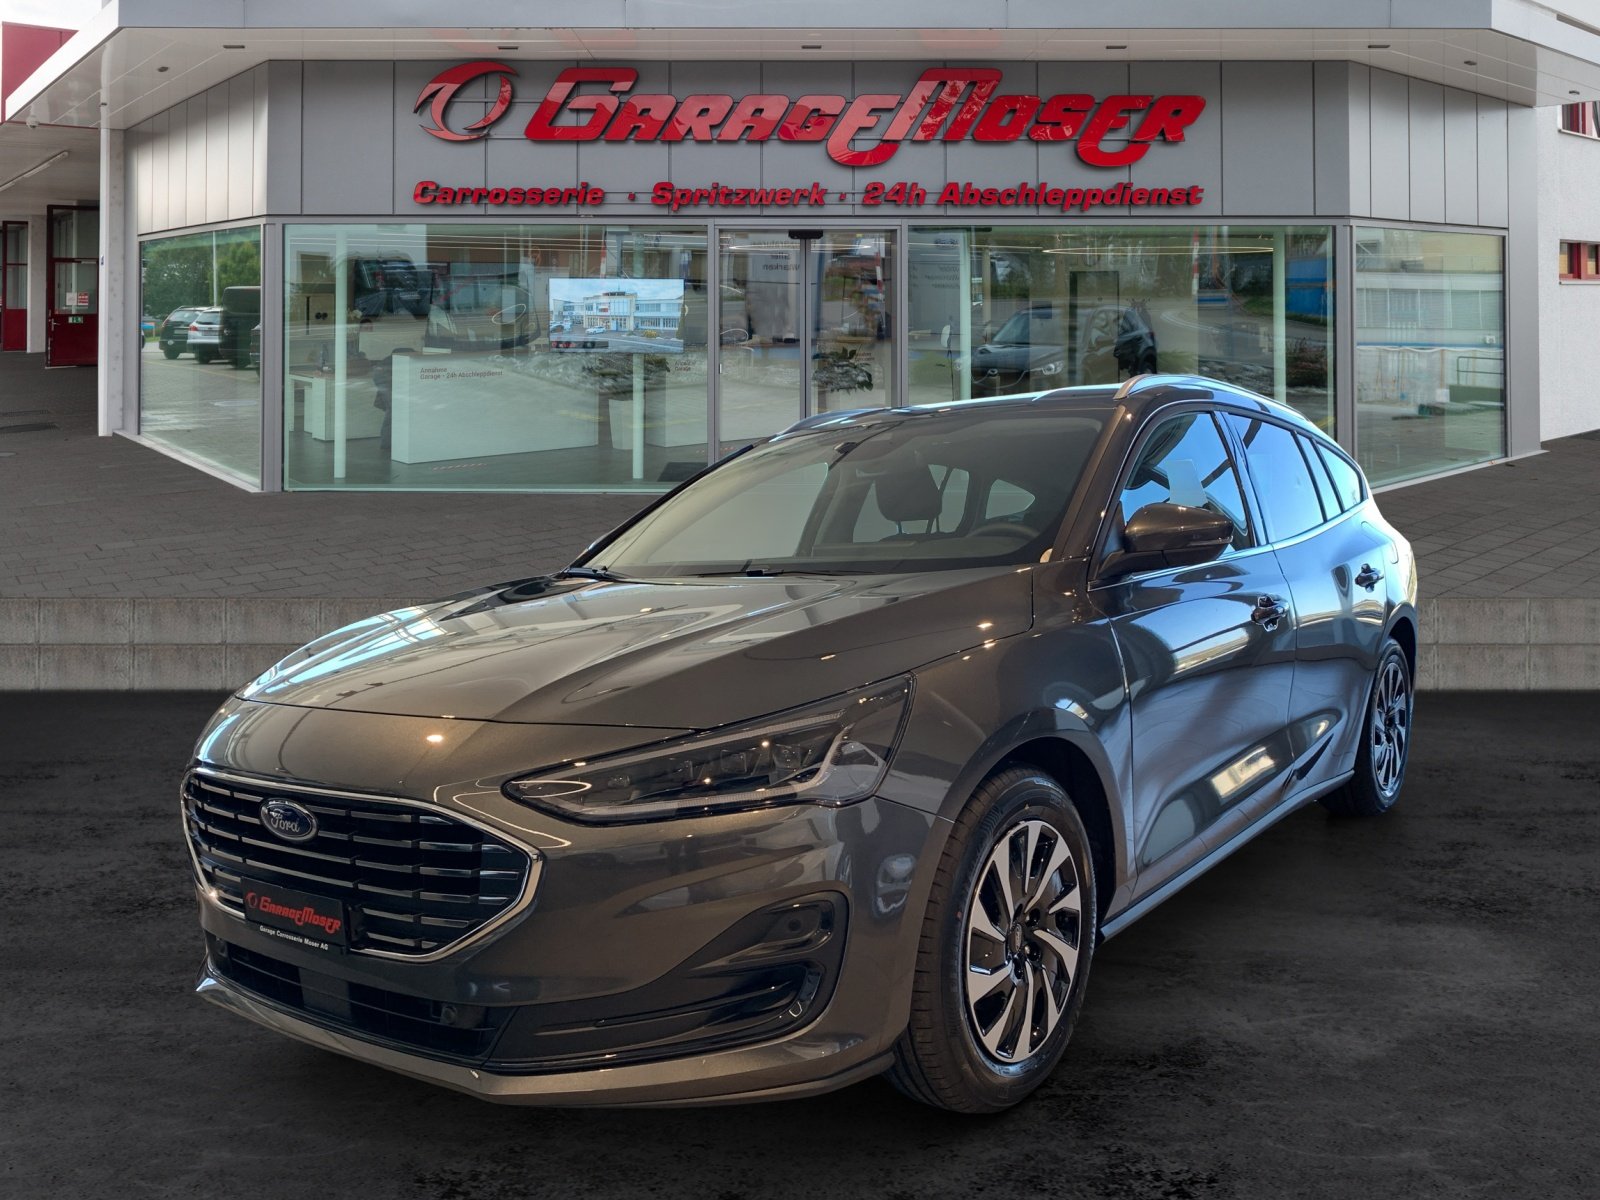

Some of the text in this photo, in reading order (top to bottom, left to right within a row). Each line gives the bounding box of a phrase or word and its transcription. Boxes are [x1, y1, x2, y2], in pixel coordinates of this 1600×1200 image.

[413, 181, 1204, 212] Carrosserie Spritzwerk 24h Abschleppdienst
[270, 810, 300, 833] Ford
[260, 925, 276, 936] Garage
[304, 937, 320, 948] Moser
[320, 942, 329, 950] AG
